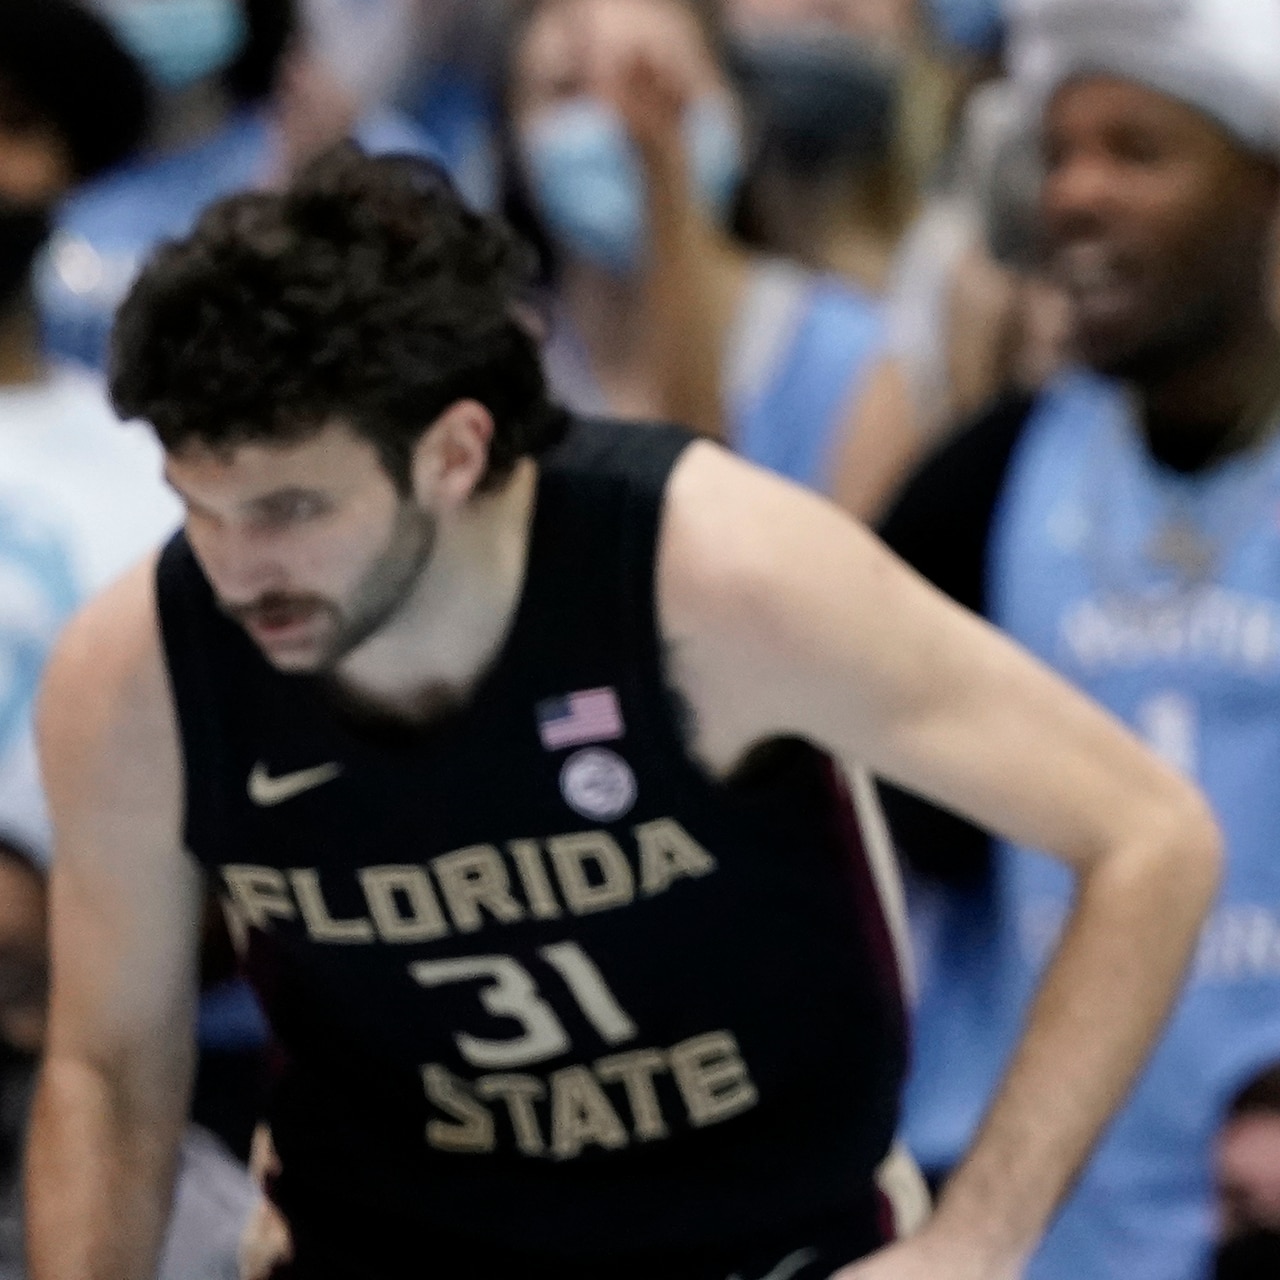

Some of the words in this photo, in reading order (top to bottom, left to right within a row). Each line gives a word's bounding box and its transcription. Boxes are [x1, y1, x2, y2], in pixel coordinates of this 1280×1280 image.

[220, 817, 718, 946] FLORIDA
[407, 939, 639, 1070] 31
[420, 1027, 760, 1162] STATE
